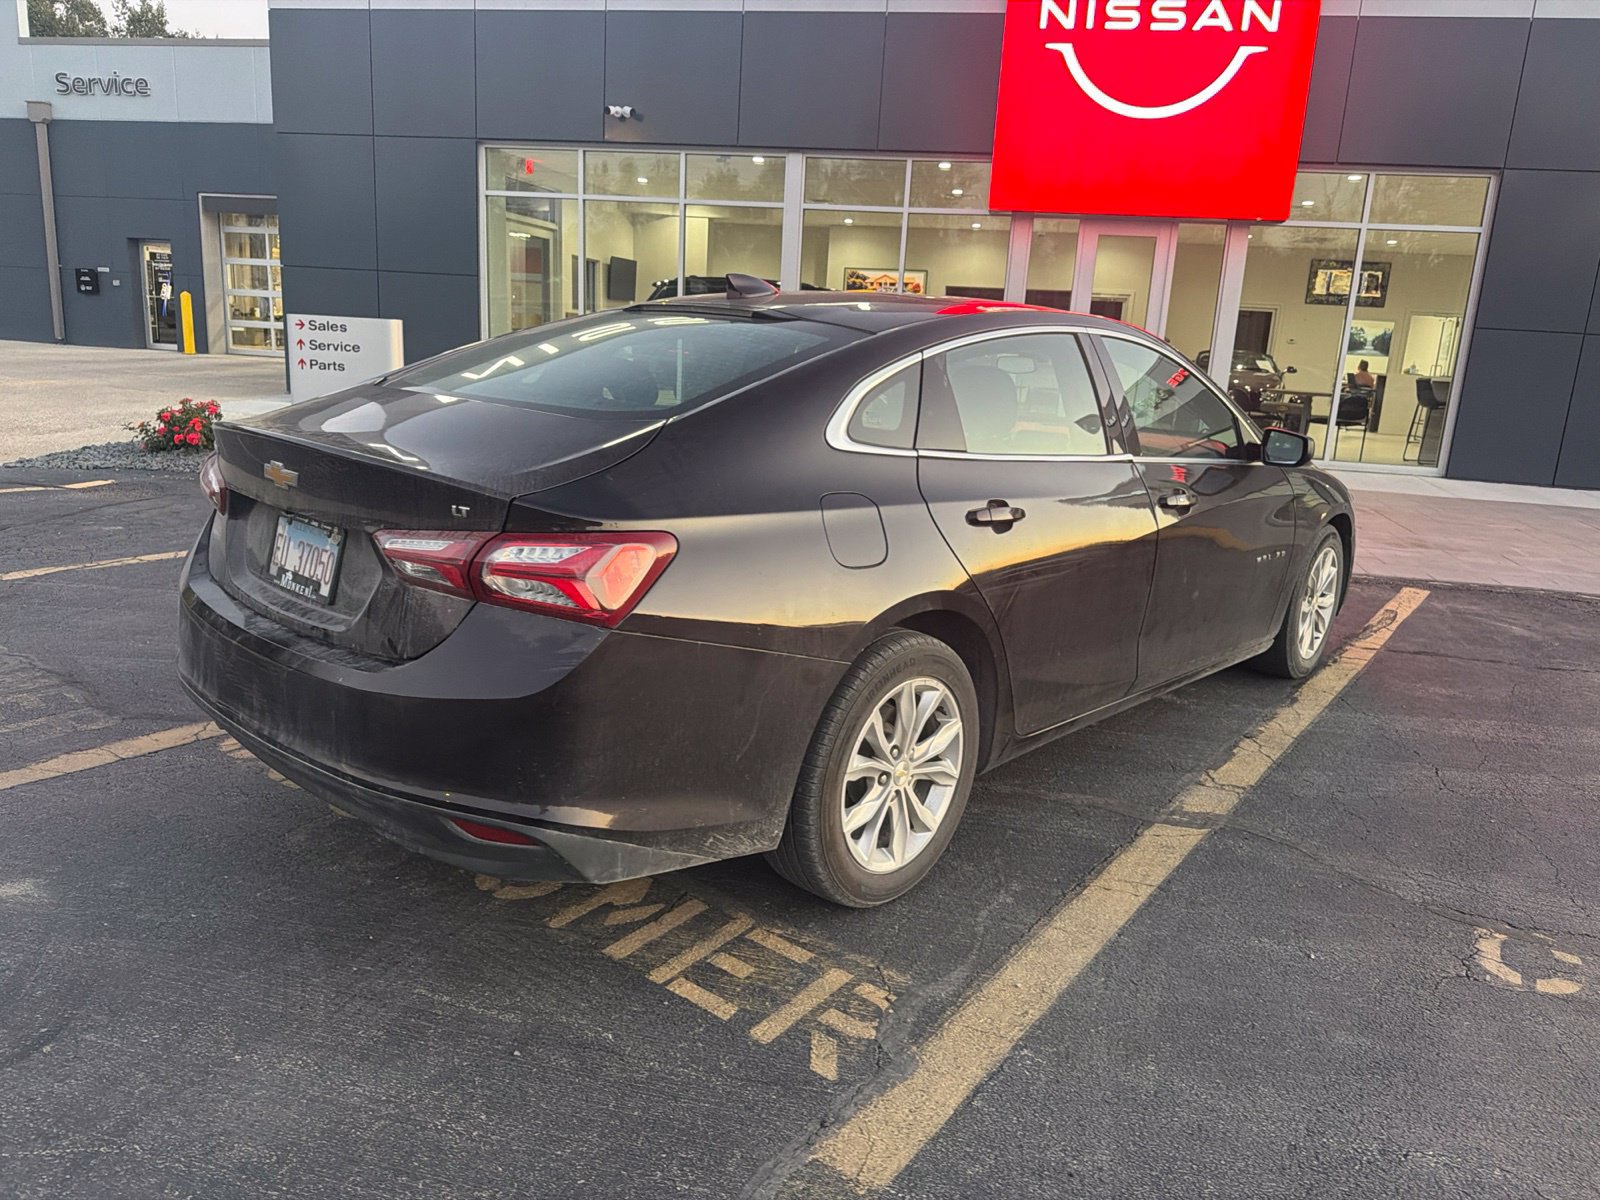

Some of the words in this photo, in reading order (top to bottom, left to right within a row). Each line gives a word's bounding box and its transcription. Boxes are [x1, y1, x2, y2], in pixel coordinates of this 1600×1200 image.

[1039, 0, 1282, 32] NISSAN
[55, 71, 150, 96] Service
[308, 319, 348, 333] Sales
[309, 339, 361, 353] Service
[309, 359, 345, 372] Parts
[451, 504, 470, 518] LT
[293, 540, 336, 585] 37050
